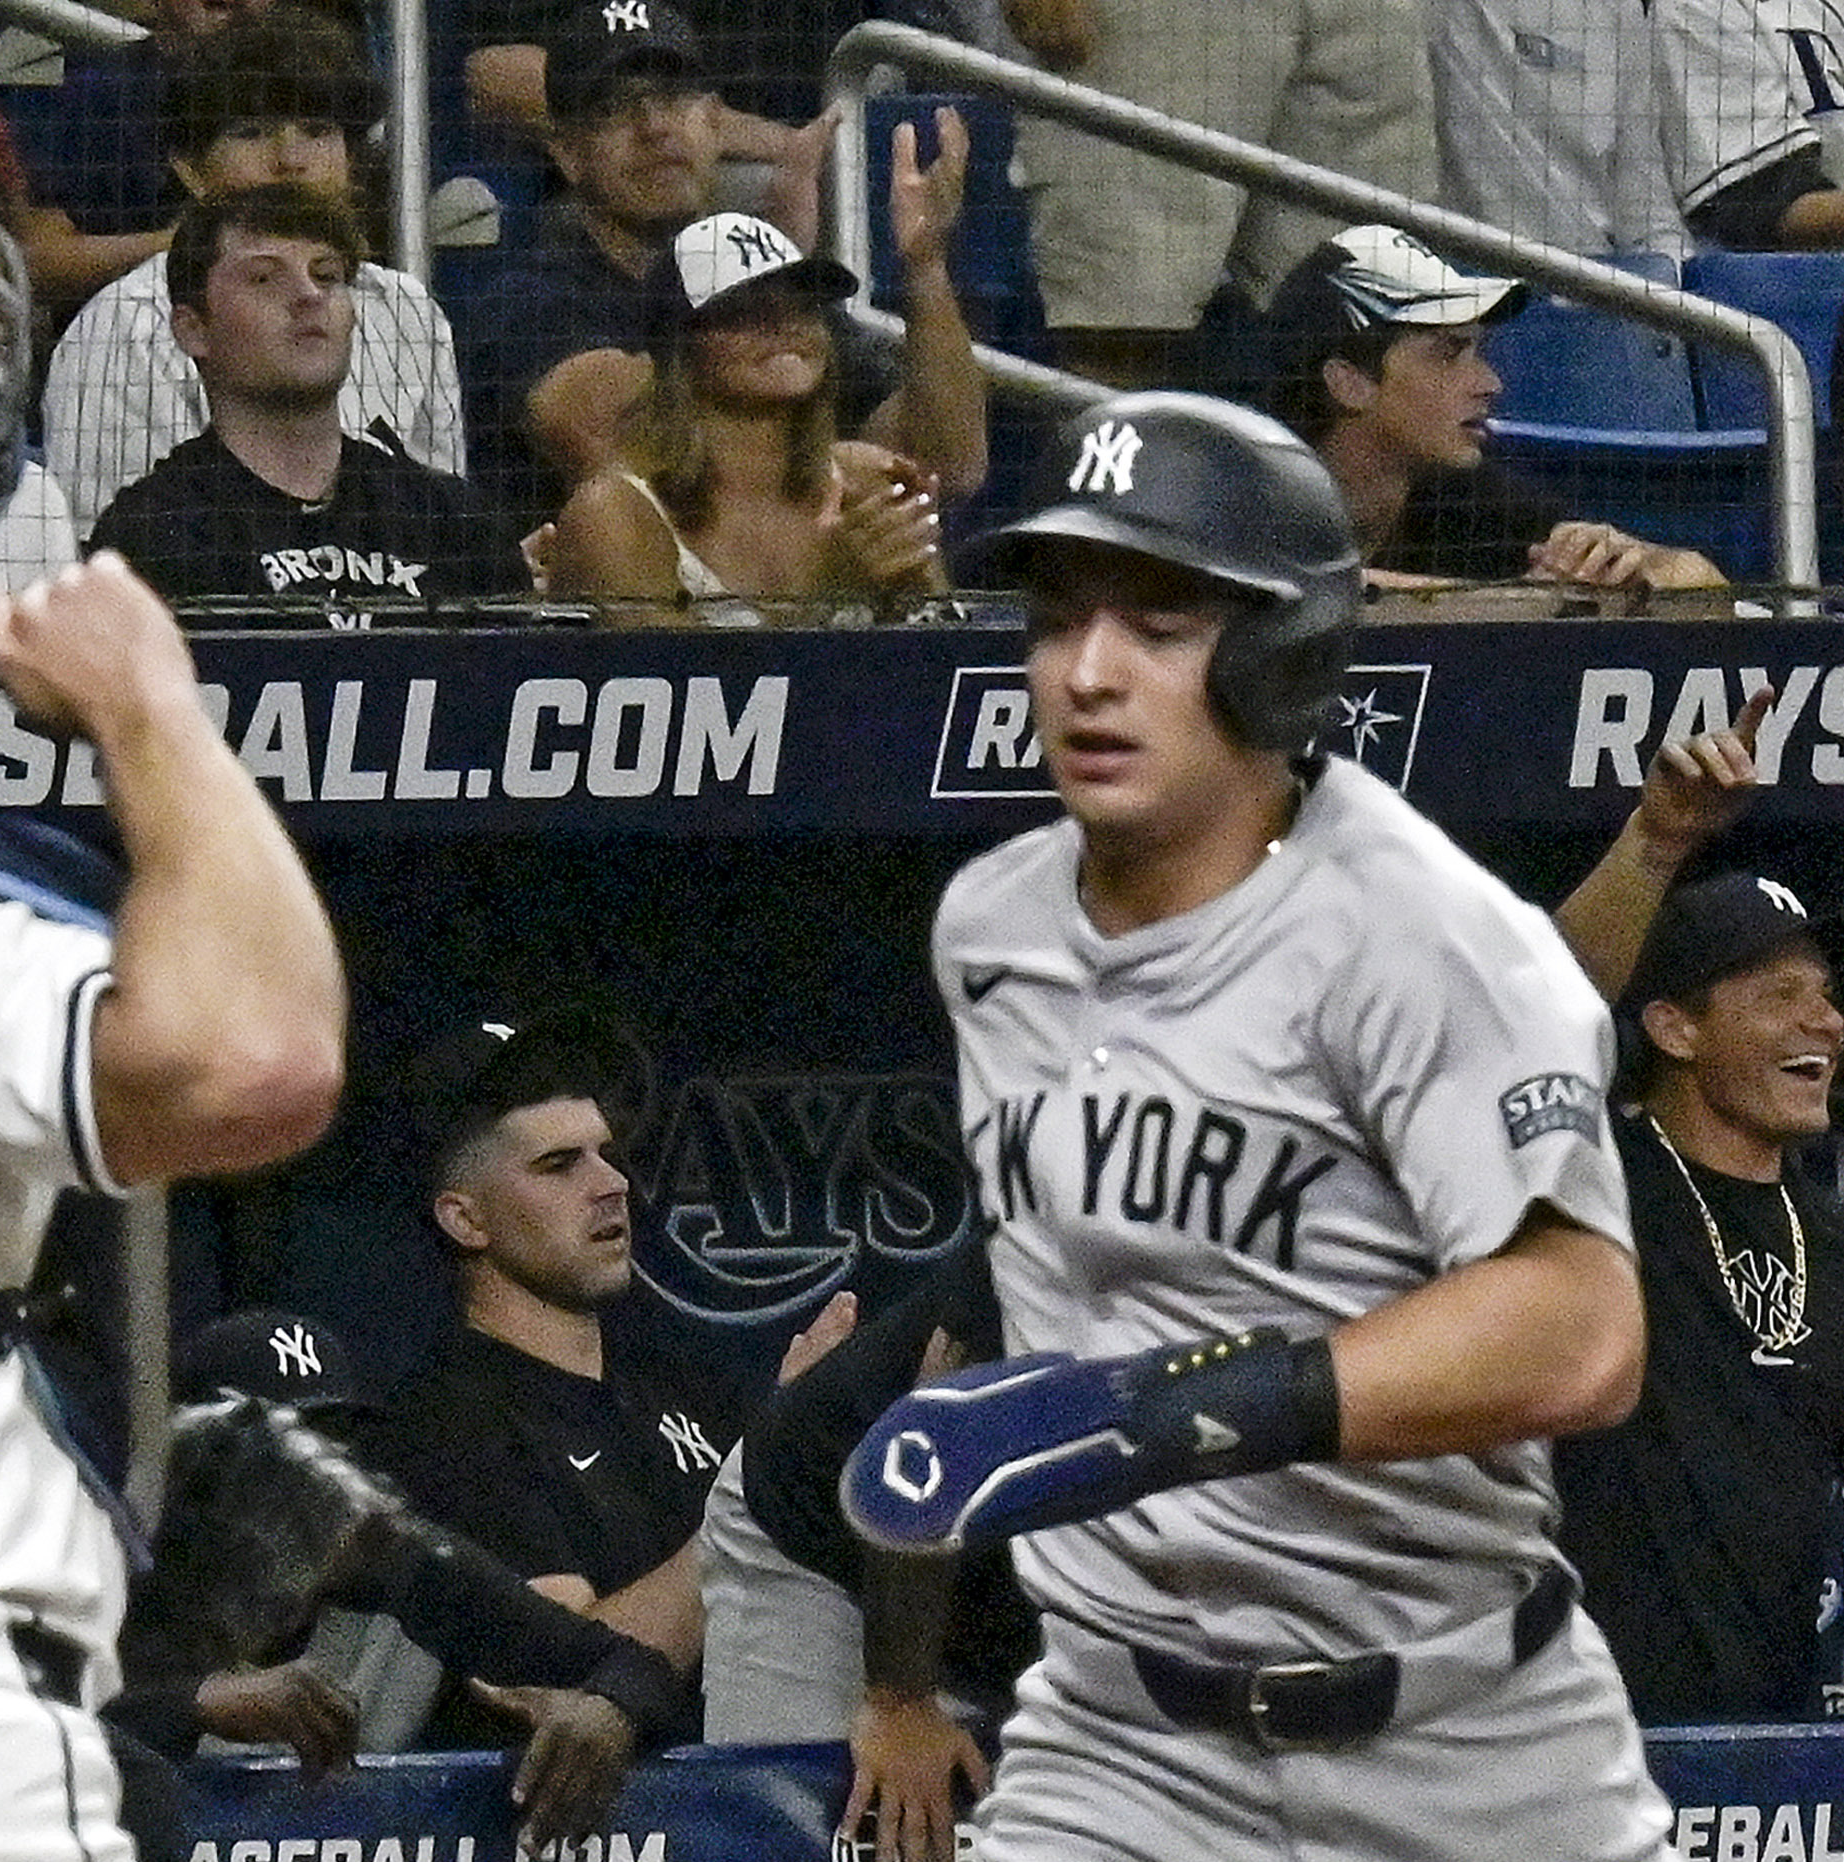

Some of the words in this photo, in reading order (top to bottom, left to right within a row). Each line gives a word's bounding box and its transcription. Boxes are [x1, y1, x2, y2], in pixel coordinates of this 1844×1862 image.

[259, 545, 428, 596] BRONX
[1077, 1092, 1339, 1274] YORK
[265, 1323, 322, 1378] NY
